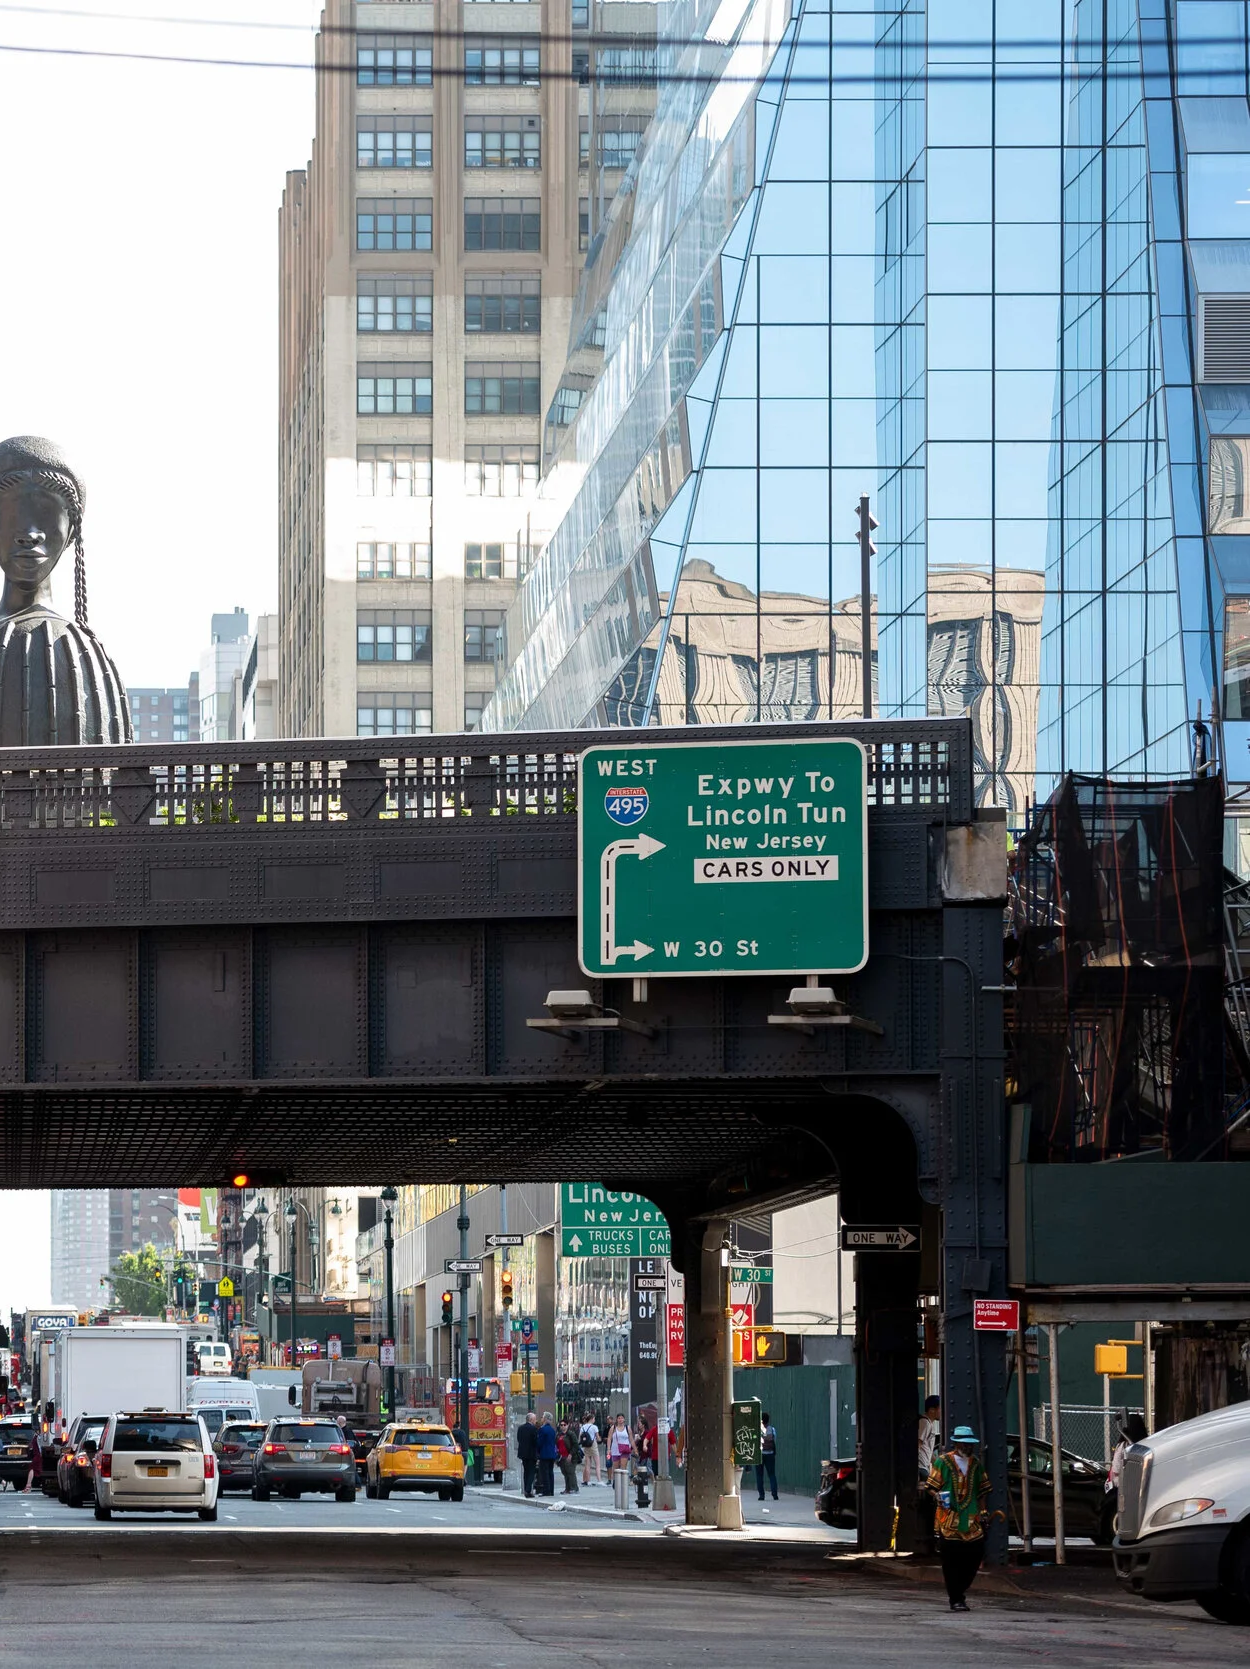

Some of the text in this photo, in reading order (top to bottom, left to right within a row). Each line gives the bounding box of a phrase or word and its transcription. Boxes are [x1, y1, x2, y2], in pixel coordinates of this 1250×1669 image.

[597, 759, 658, 777] WEST
[610, 788, 644, 796] INTERSTATE
[698, 771, 835, 800] Expwy To
[608, 798, 645, 816] 495
[687, 802, 846, 827] Lincoln Tun
[706, 832, 827, 852] New Jersey
[702, 859, 830, 879] CARS ONLY
[663, 940, 759, 957] W 30 St
[584, 1208, 667, 1222] New Jer
[589, 1230, 671, 1241] TRUCKS CAR
[853, 1233, 909, 1244] ONE WAY
[592, 1243, 671, 1254] BUSES ONL
[638, 1261, 654, 1273] LE
[733, 1269, 743, 1281] W
[747, 1268, 761, 1281] 30
[671, 1279, 683, 1288] VE
[638, 1305, 656, 1319] OP
[671, 1307, 684, 1316] PR
[38, 1317, 67, 1327] GOYA
[671, 1320, 684, 1329] HA
